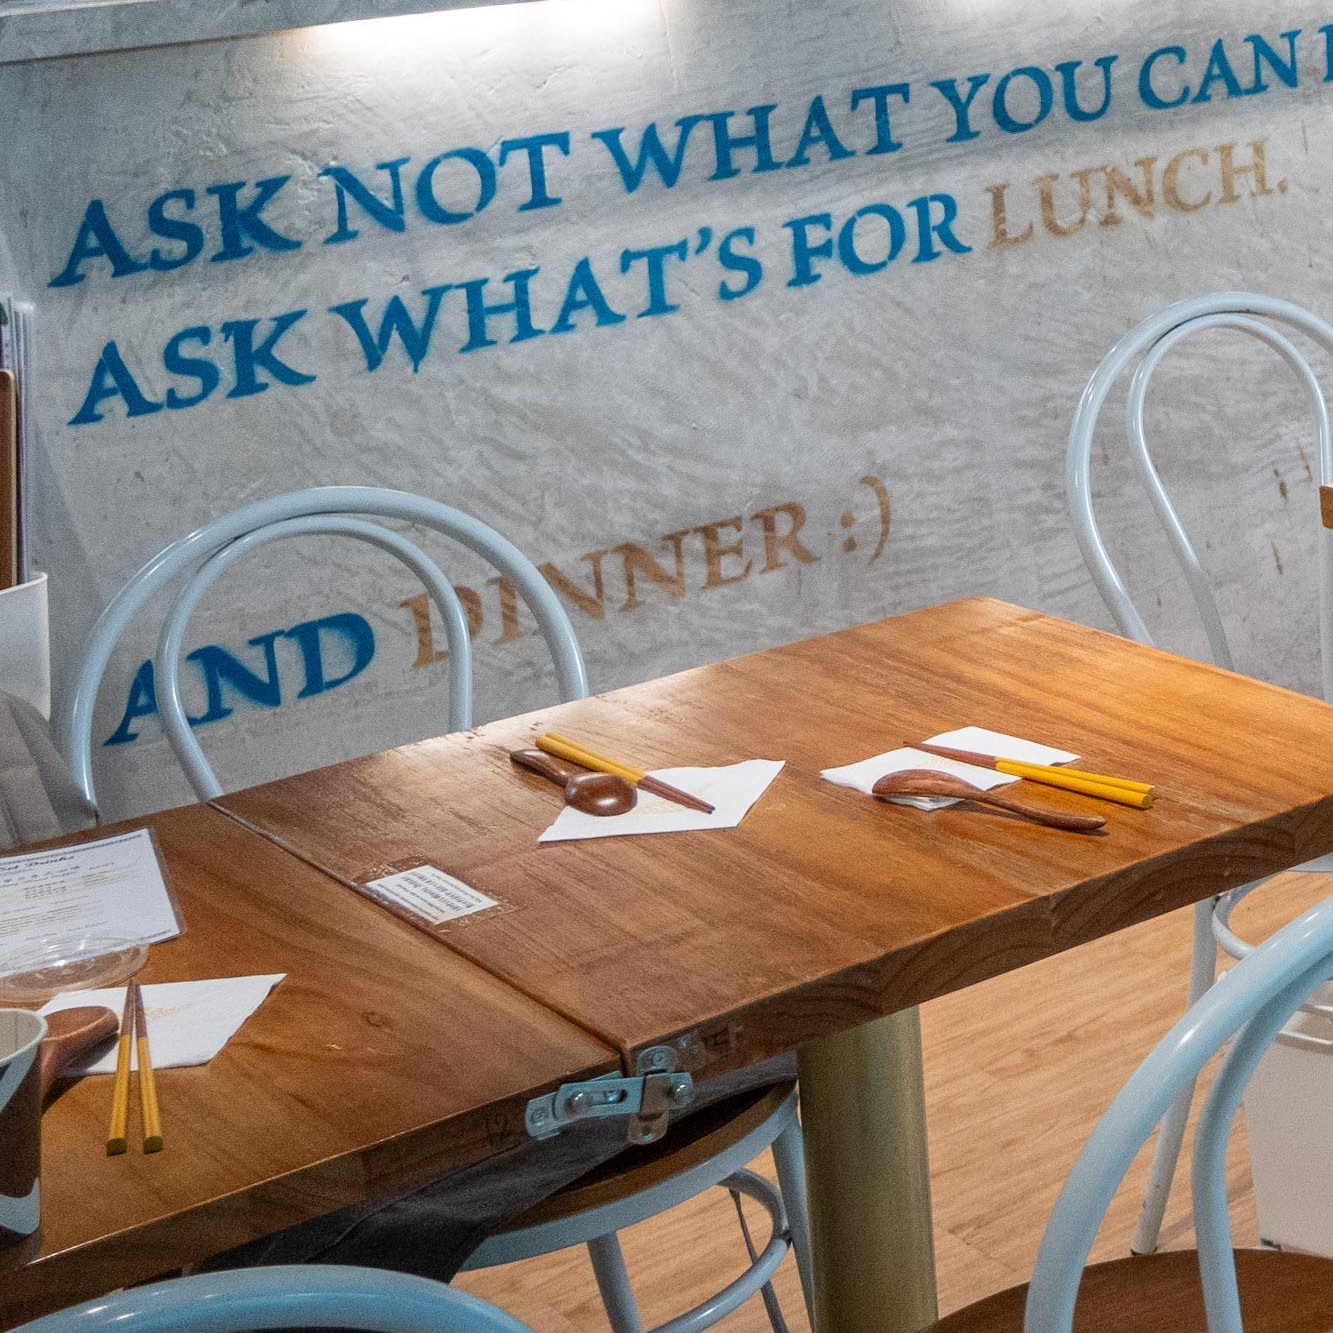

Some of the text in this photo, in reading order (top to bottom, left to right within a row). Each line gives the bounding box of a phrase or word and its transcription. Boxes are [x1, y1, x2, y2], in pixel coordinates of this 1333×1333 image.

[48, 174, 302, 288] ASK
[319, 131, 570, 245] NOT
[592, 82, 910, 194] WHAT
[930, 56, 1117, 143] YOU
[1139, 29, 1300, 110] CAN
[67, 309, 317, 425] ASK
[784, 192, 972, 288] FOR
[982, 137, 1289, 251] LUNCH.
[102, 611, 376, 747] AND
[400, 501, 820, 667] DINNER
